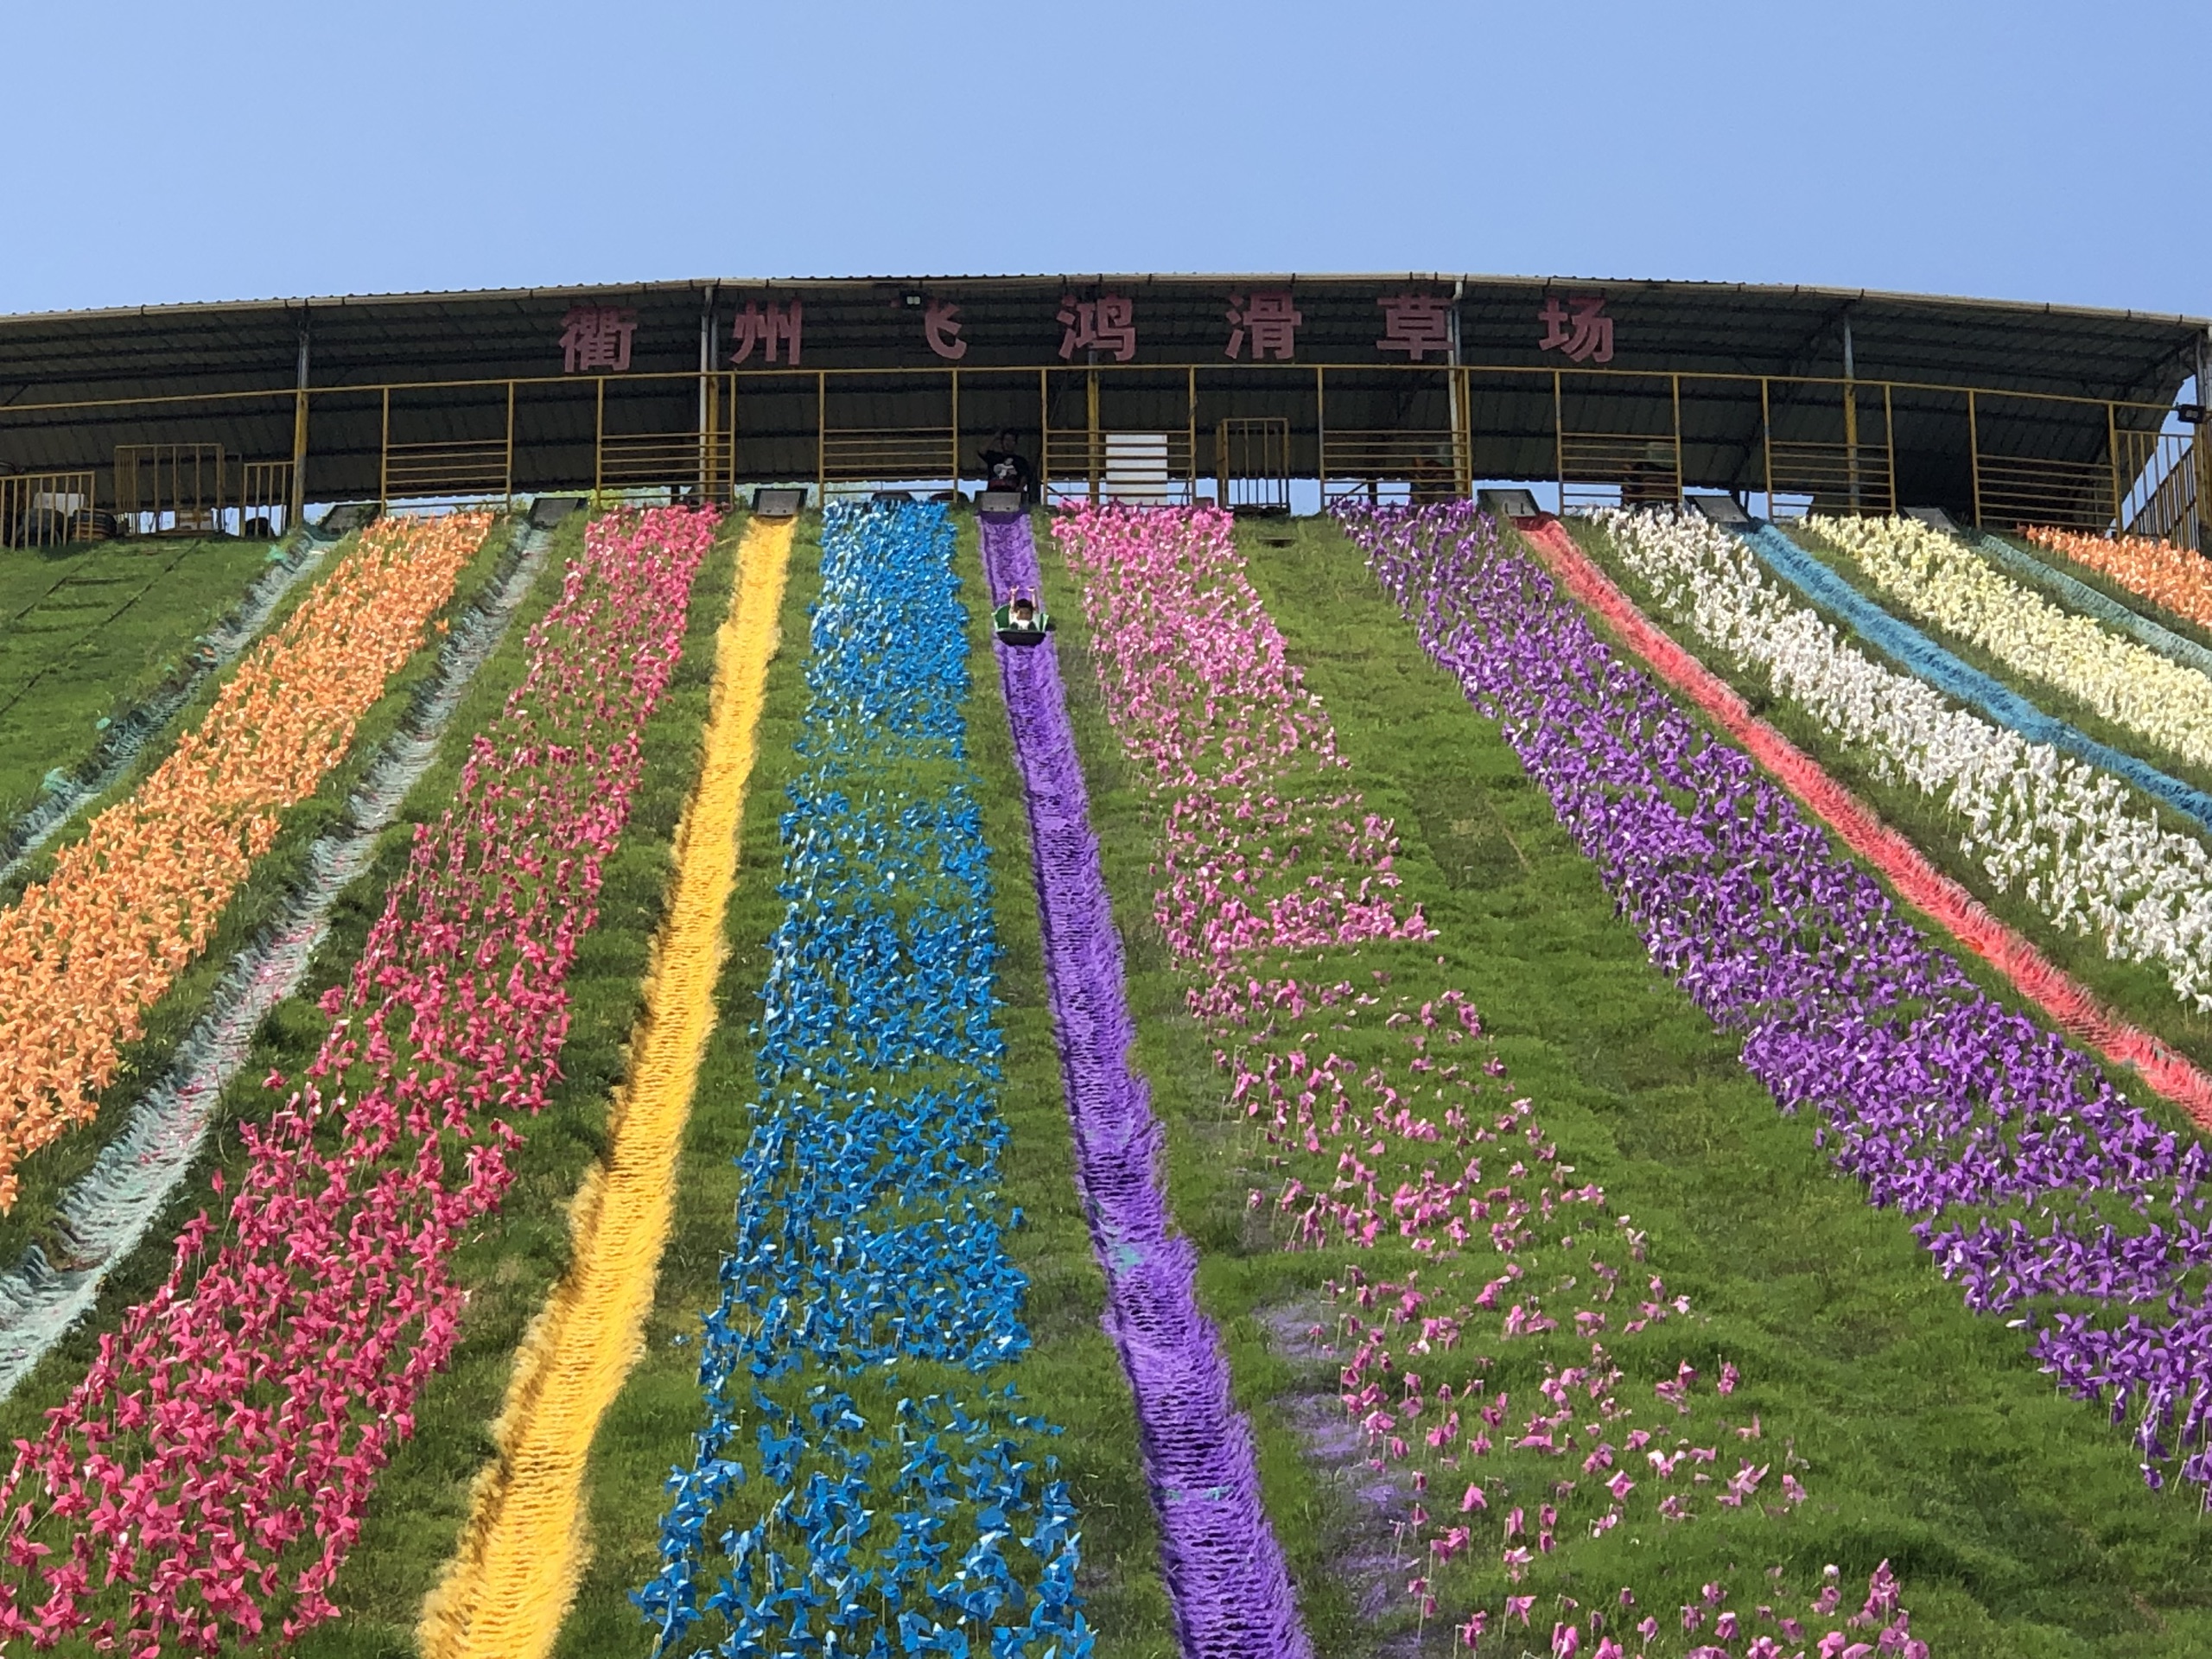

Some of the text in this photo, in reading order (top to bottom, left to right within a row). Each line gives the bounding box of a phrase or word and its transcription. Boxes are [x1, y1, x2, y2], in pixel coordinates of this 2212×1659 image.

[558, 293, 1614, 372] 衢州飞鸿滑草场
